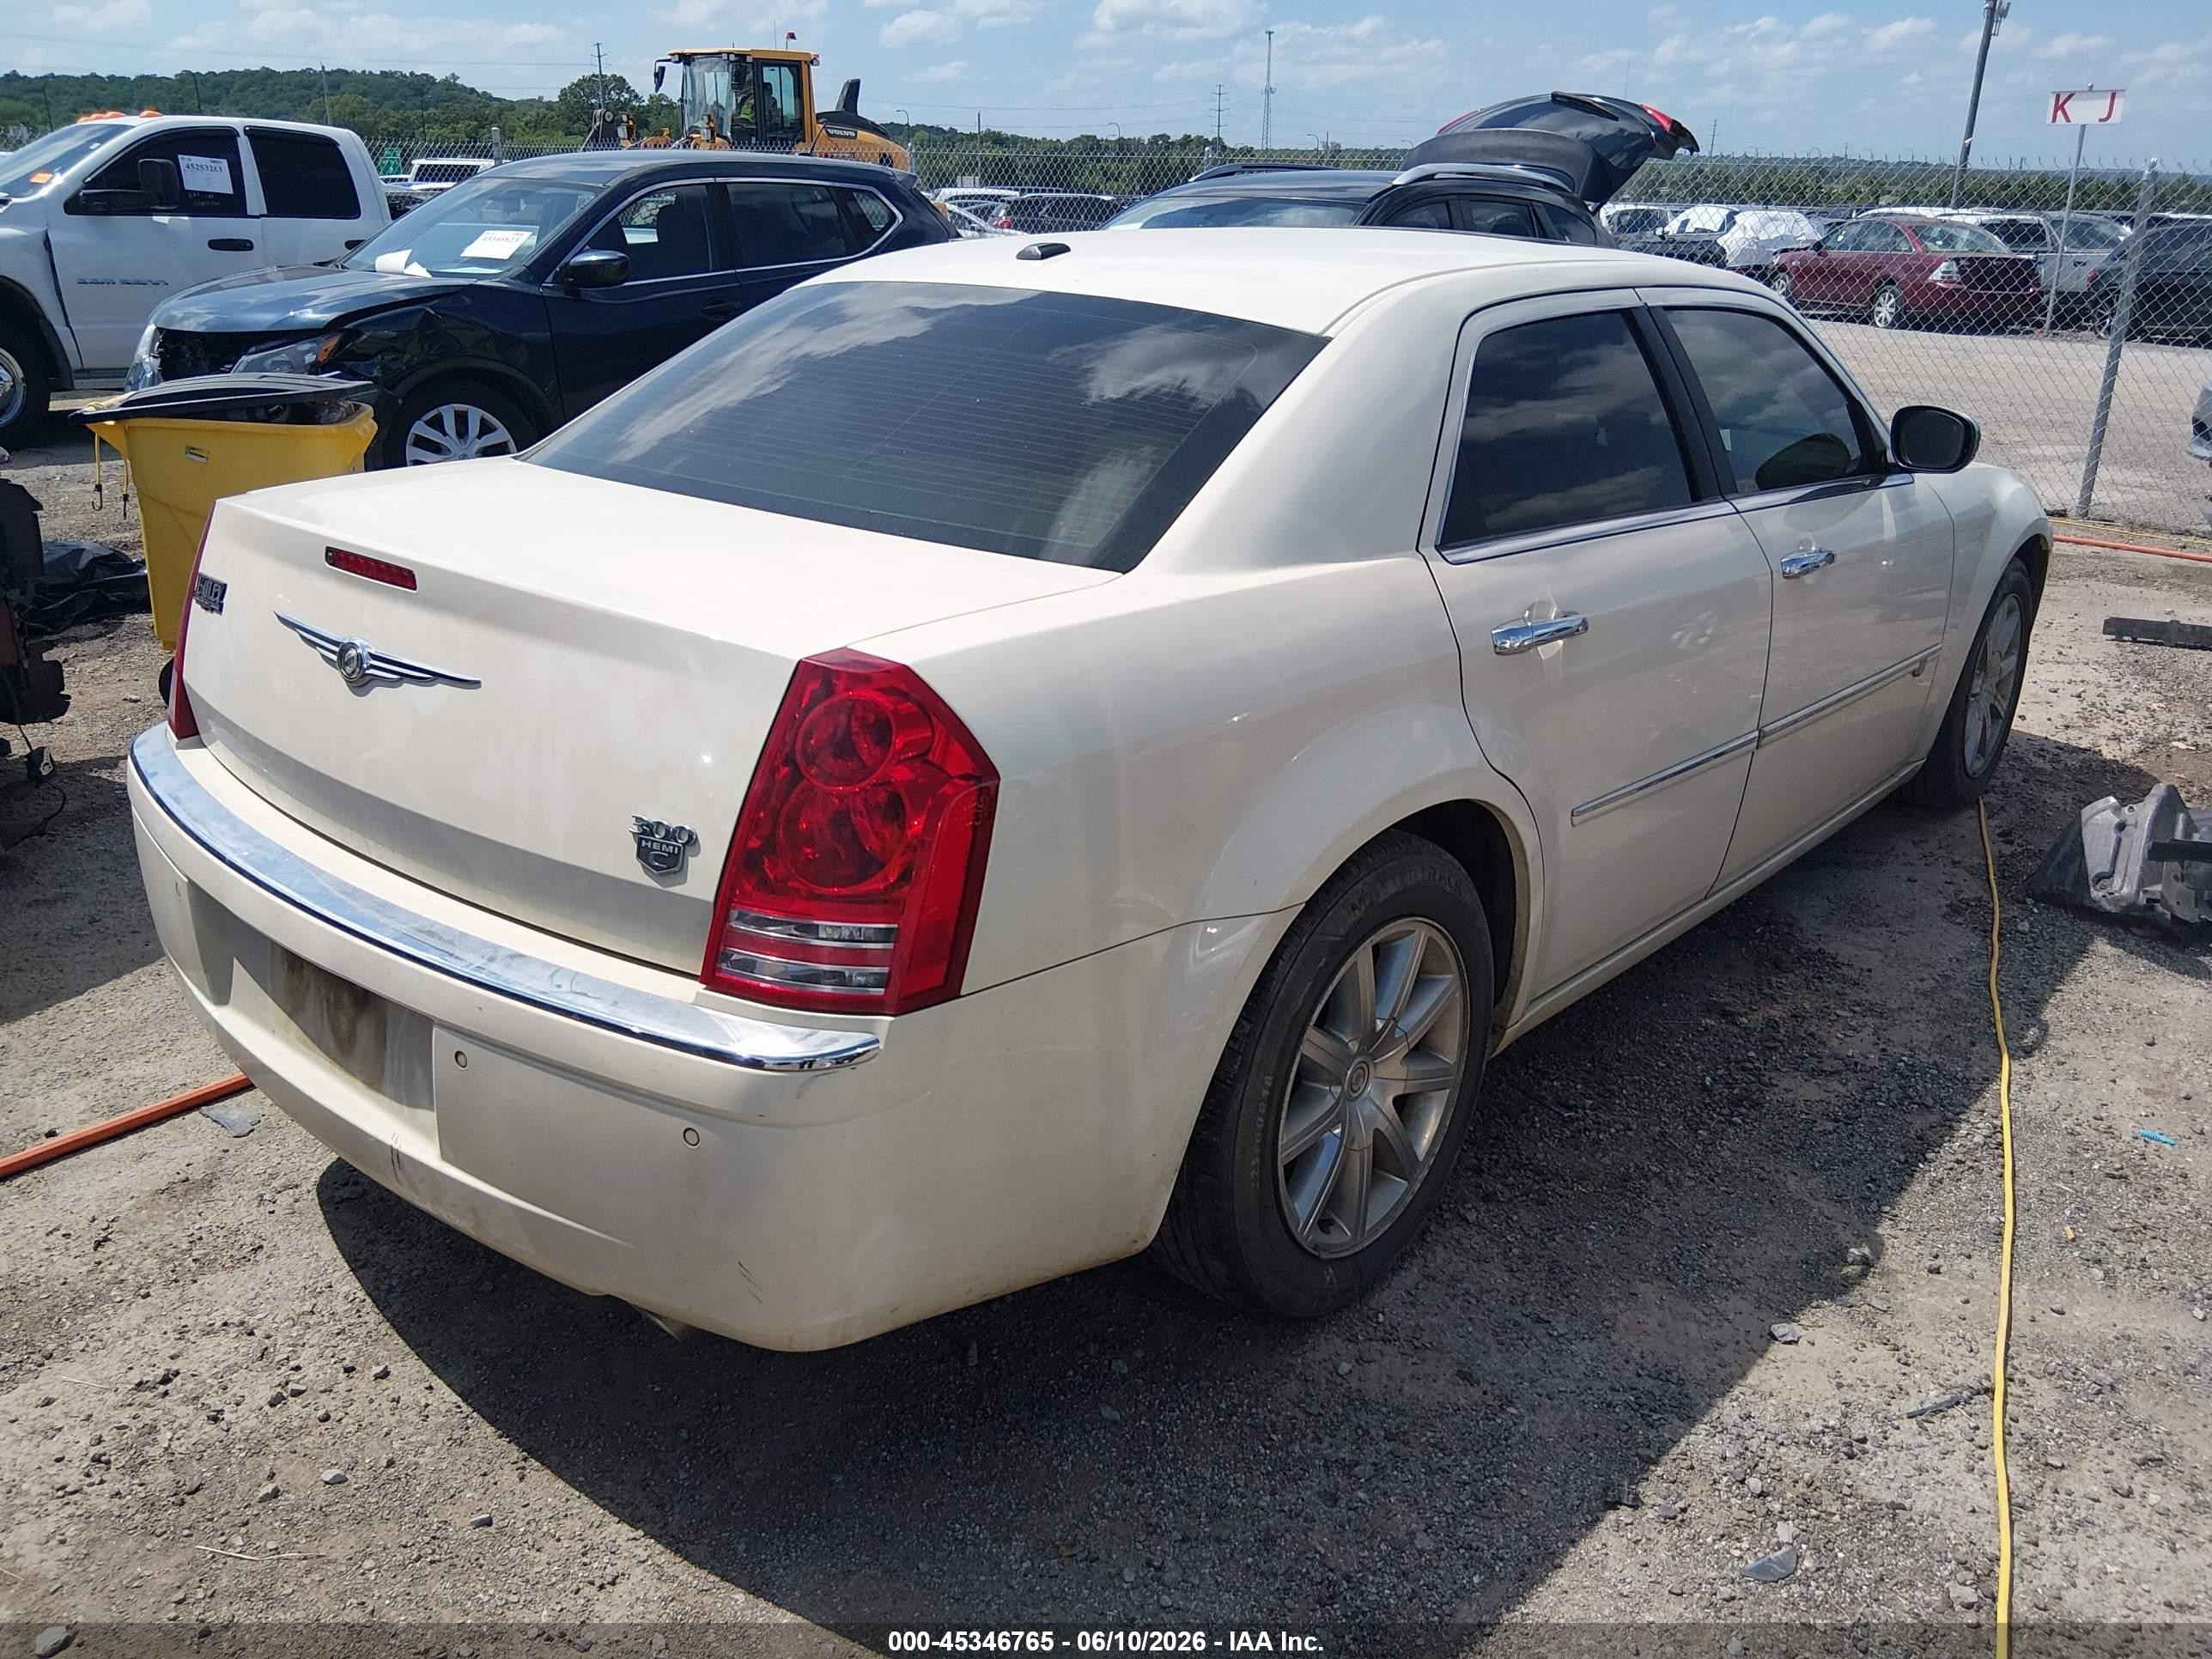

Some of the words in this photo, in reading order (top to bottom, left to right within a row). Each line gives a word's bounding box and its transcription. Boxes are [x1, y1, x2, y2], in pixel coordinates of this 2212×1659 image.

[2051, 92, 2075, 124] K
[2098, 92, 2117, 123] J
[827, 128, 856, 137] VOLVO
[628, 813, 697, 845] 300
[641, 839, 679, 854] HEMI
[648, 851, 668, 868] C
